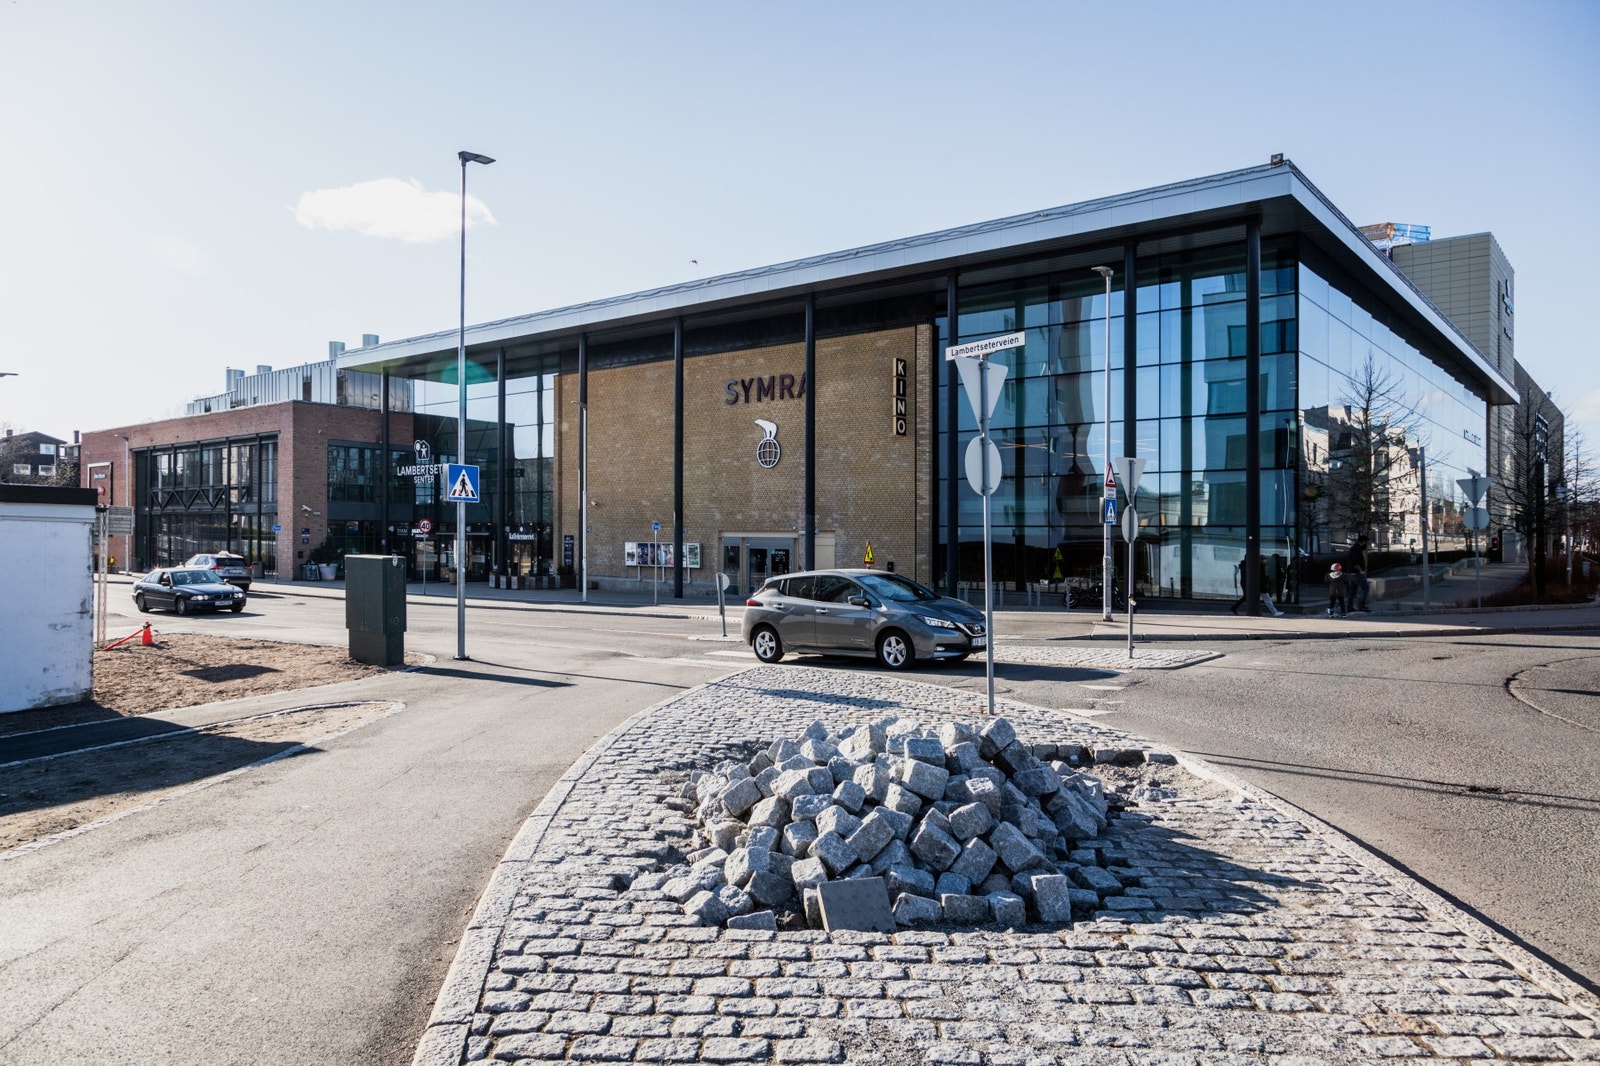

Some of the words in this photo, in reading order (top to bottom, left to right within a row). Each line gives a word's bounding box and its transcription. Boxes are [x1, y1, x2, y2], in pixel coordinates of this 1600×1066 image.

[951, 336, 1019, 357] Lambertseterveien
[897, 360, 906, 434] KINO
[397, 464, 443, 476] LAMBERTSET
[413, 475, 435, 484] SENTER
[421, 522, 430, 530] 40
